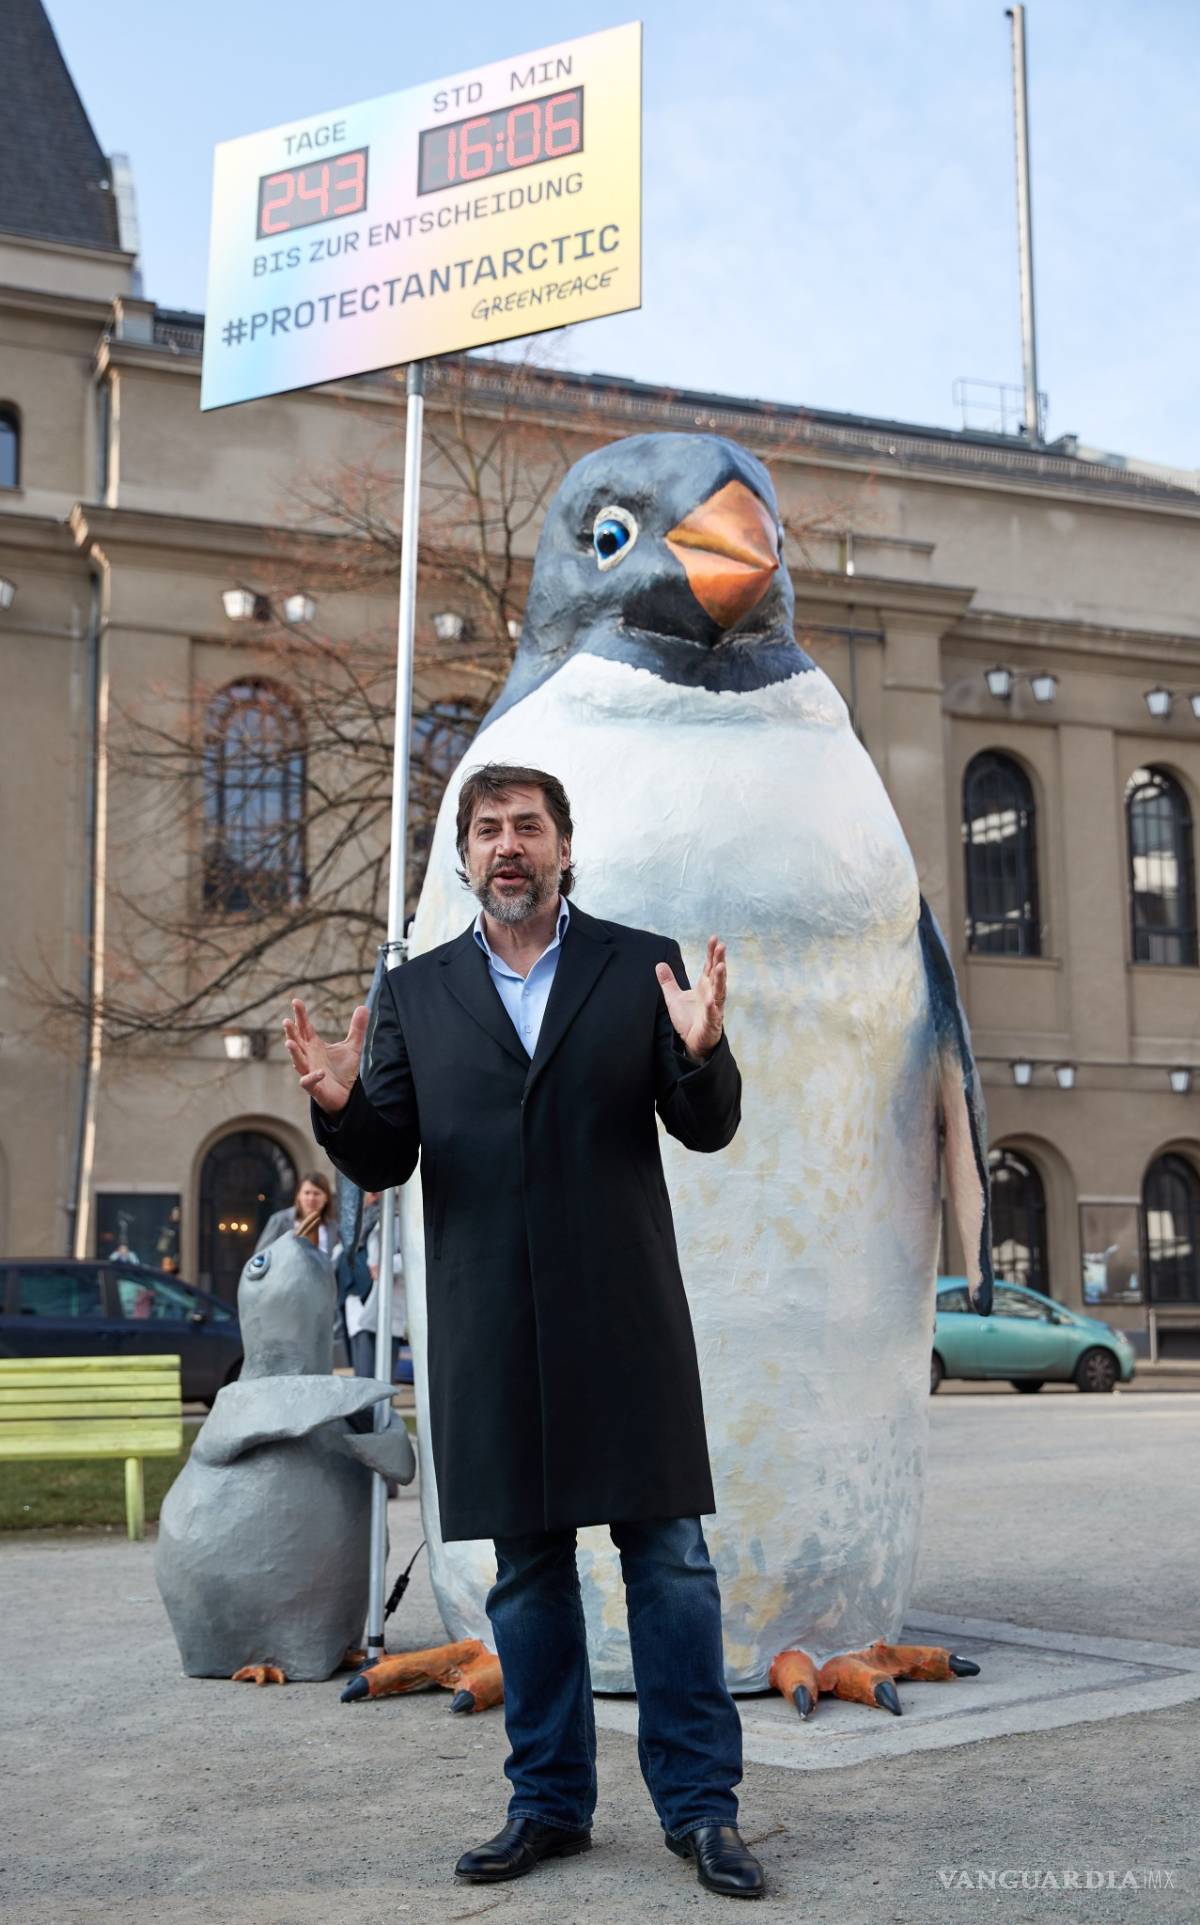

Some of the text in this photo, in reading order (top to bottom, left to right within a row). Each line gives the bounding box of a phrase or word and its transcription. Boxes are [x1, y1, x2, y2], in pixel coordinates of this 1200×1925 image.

[284, 55, 573, 156] TAGE STD MIN
[447, 93, 580, 181] 16:06
[253, 172, 584, 277] BIS ZUR ENTSCHEIDUNG
[260, 152, 365, 235] 243
[222, 224, 620, 347] #PROTECTANTARCTIC
[471, 268, 619, 321] GREENPEACE
